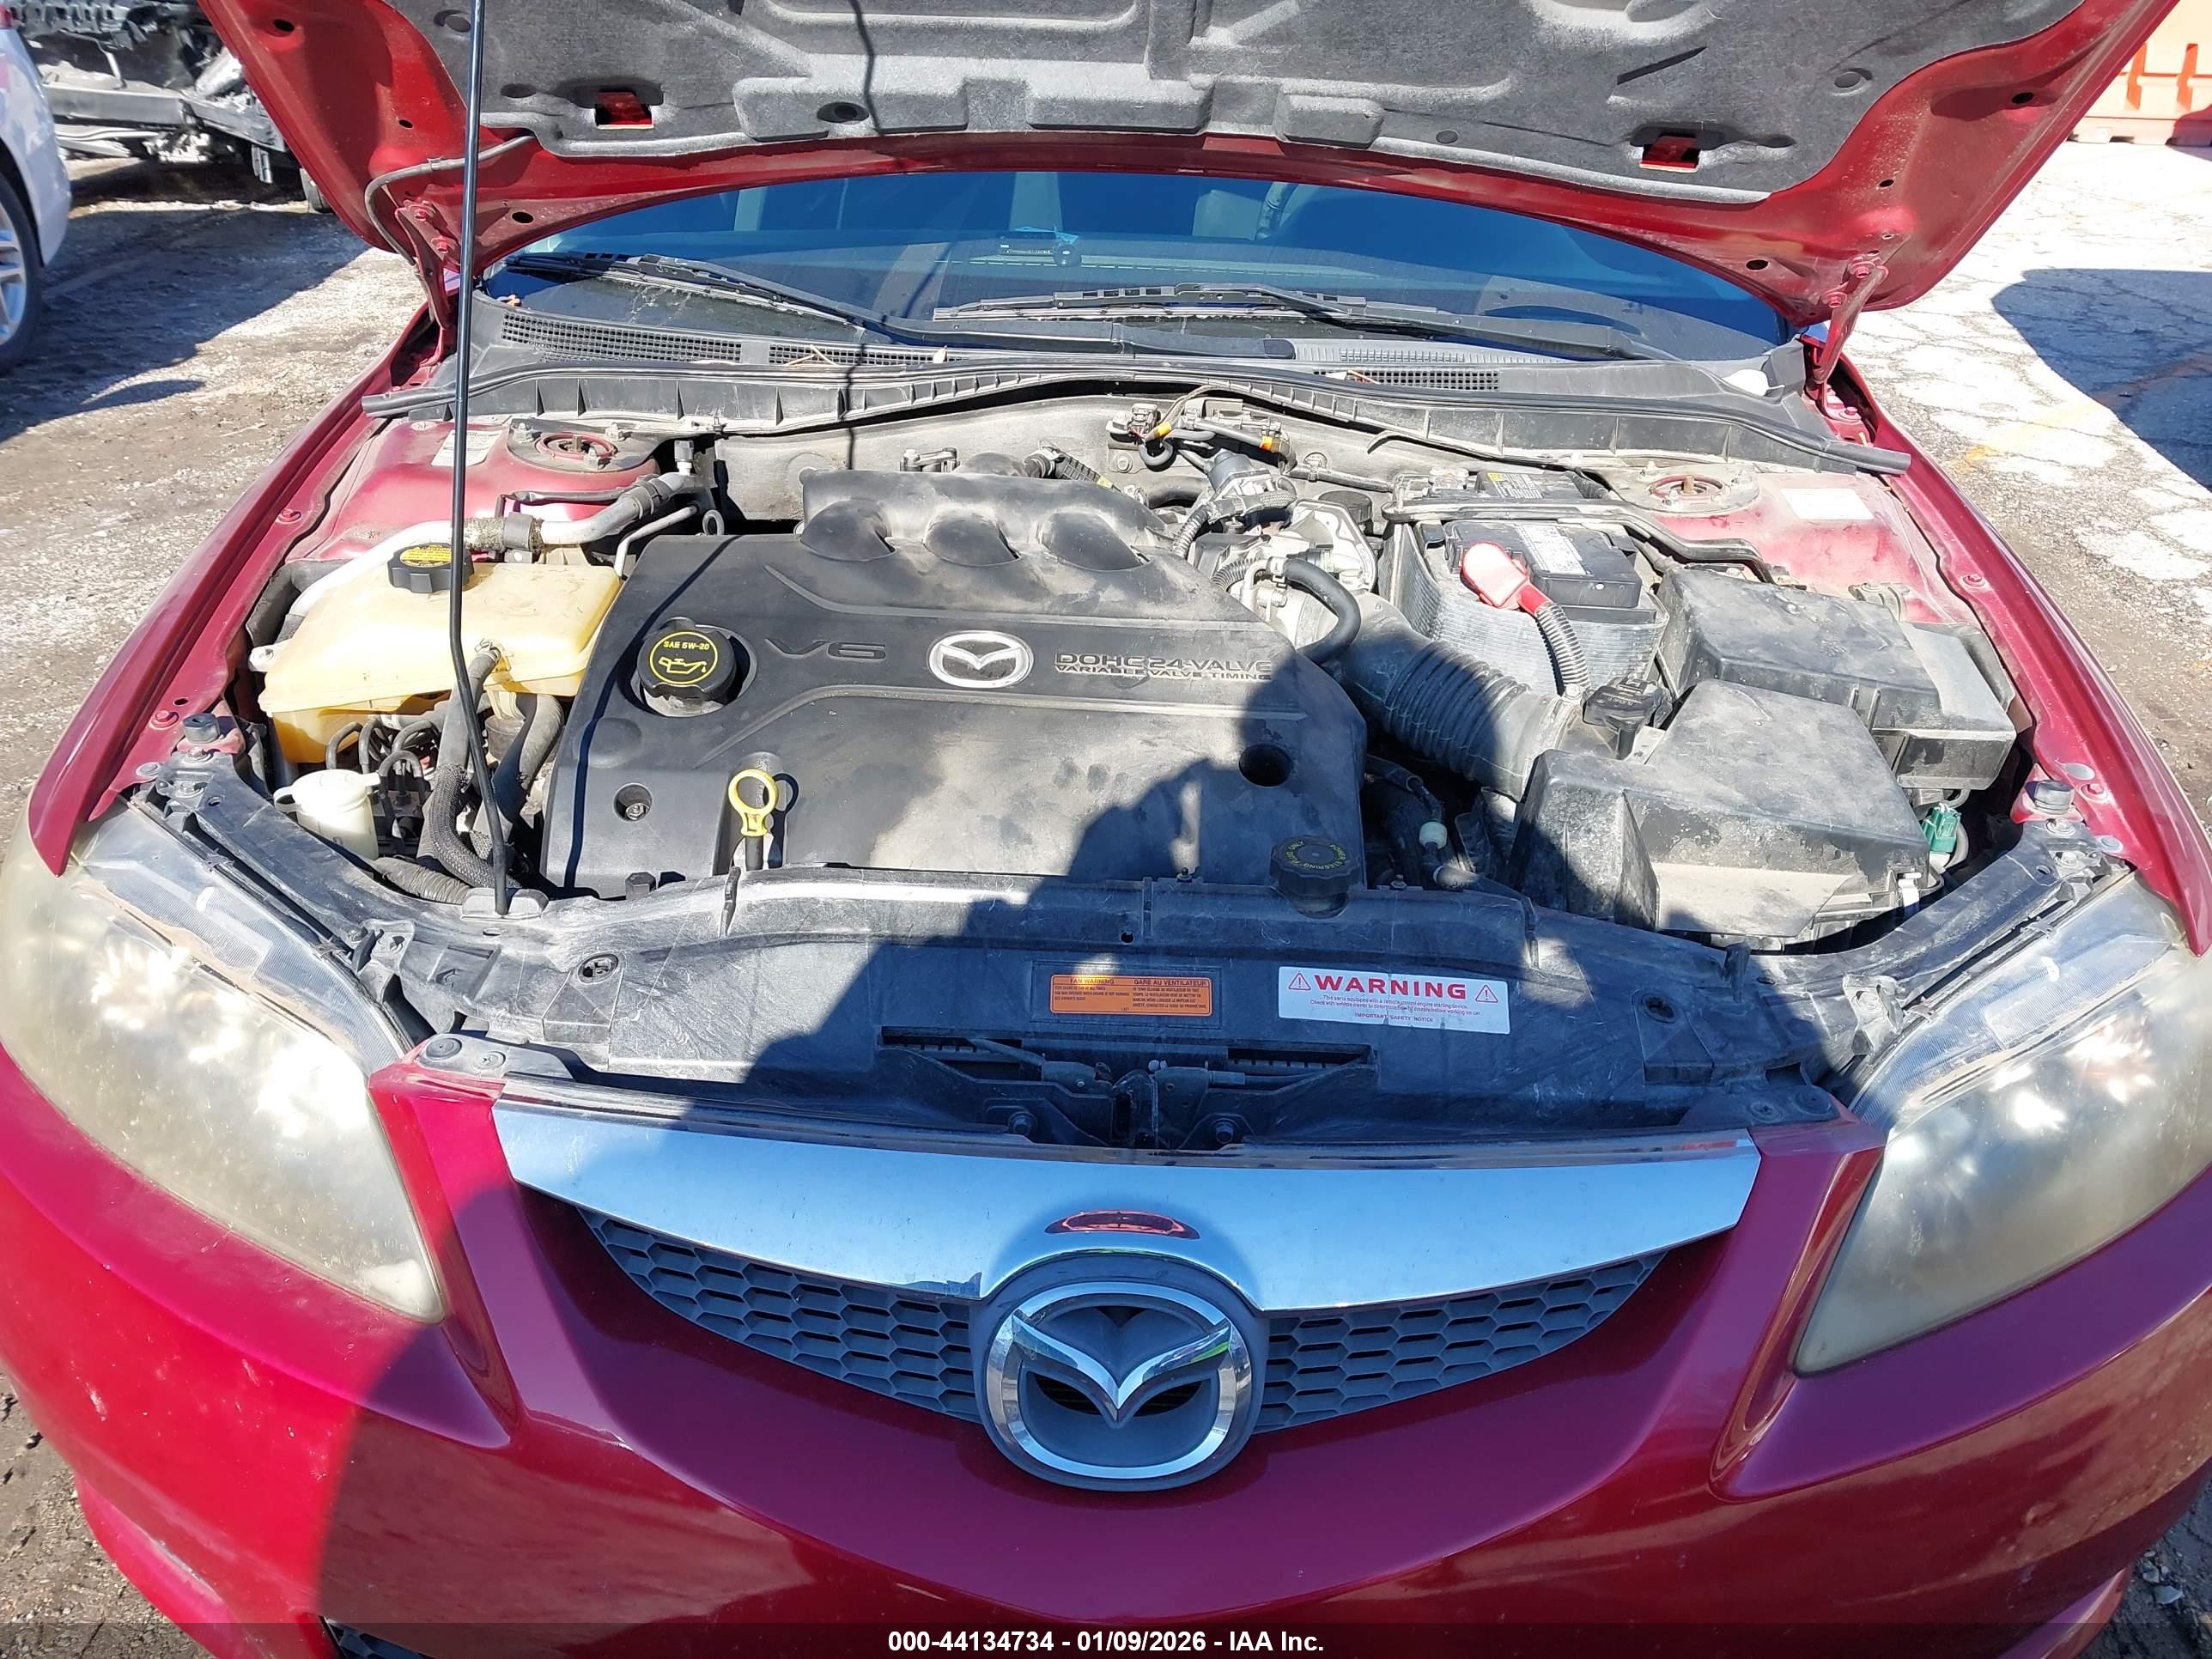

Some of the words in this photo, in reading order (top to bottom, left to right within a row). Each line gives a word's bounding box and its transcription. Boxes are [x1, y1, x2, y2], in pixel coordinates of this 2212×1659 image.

[682, 641, 710, 650] 5W-20
[765, 637, 887, 660] V6
[1054, 653, 1144, 667] DOHC
[1149, 658, 1272, 672] 24-VALVE
[1054, 665, 1146, 676] VARIABLE
[1147, 669, 1202, 678] VALVE
[1212, 672, 1272, 681] TIMING
[1314, 975, 1467, 1000] WARNING
